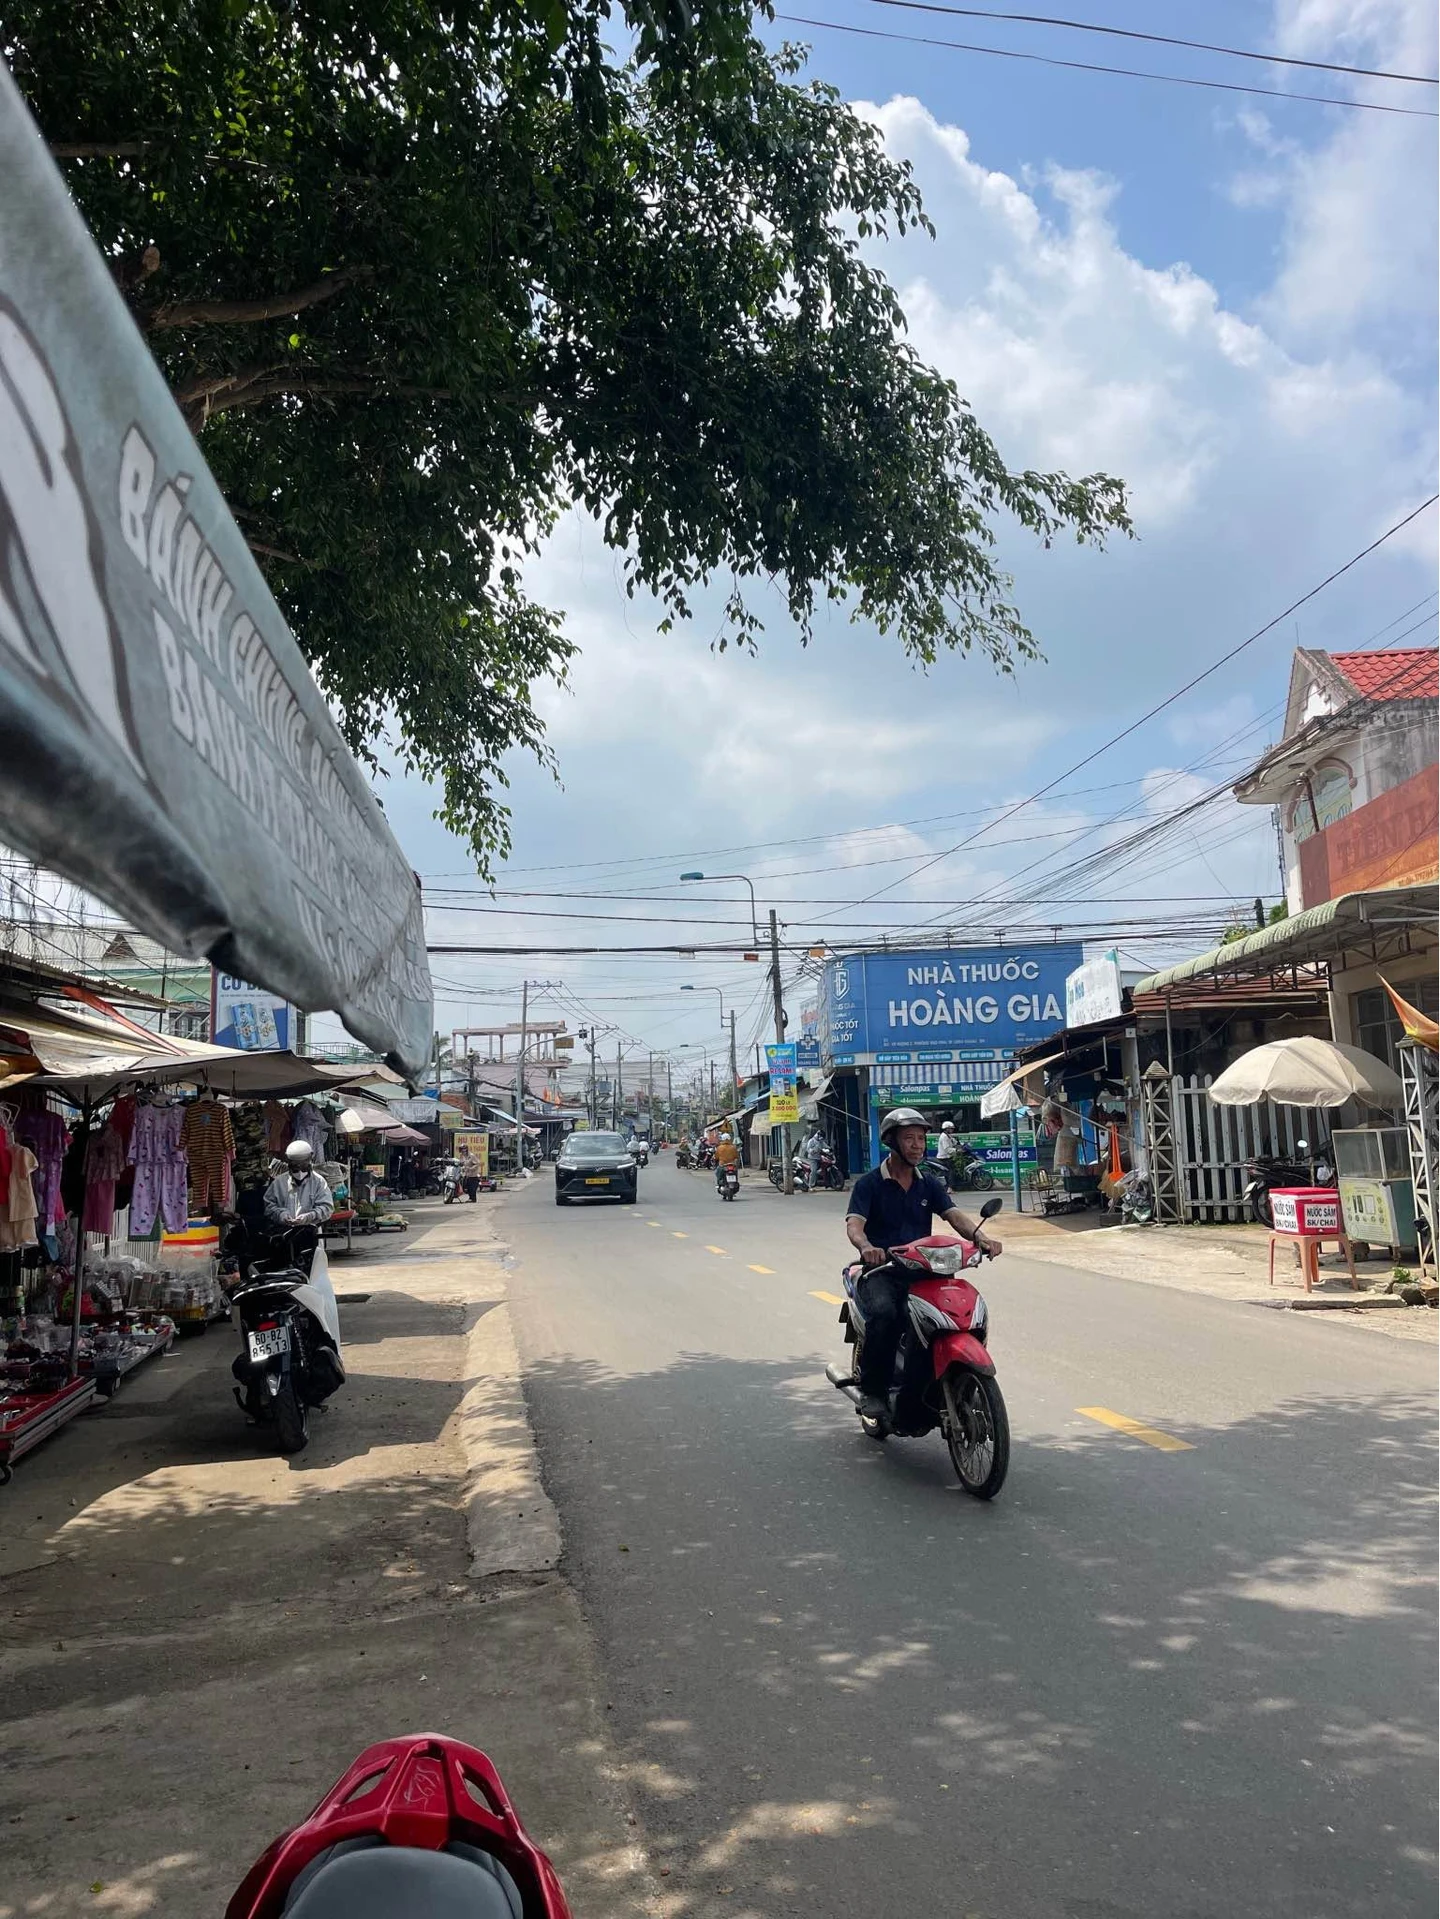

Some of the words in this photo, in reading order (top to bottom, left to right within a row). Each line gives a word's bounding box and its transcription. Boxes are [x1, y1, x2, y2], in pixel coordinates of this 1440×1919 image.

[119, 419, 236, 678] BÁNH
[907, 960, 957, 986] NHÀ
[958, 956, 1040, 983] THUỐC
[888, 989, 999, 1027] HOÀNG
[1007, 993, 1064, 1022] GIA
[986, 1149, 1029, 1160] Salonas
[1306, 1206, 1323, 1217] NƯỚC
[255, 1328, 282, 1346] 60-B2
[252, 1339, 288, 1358] 855.13
